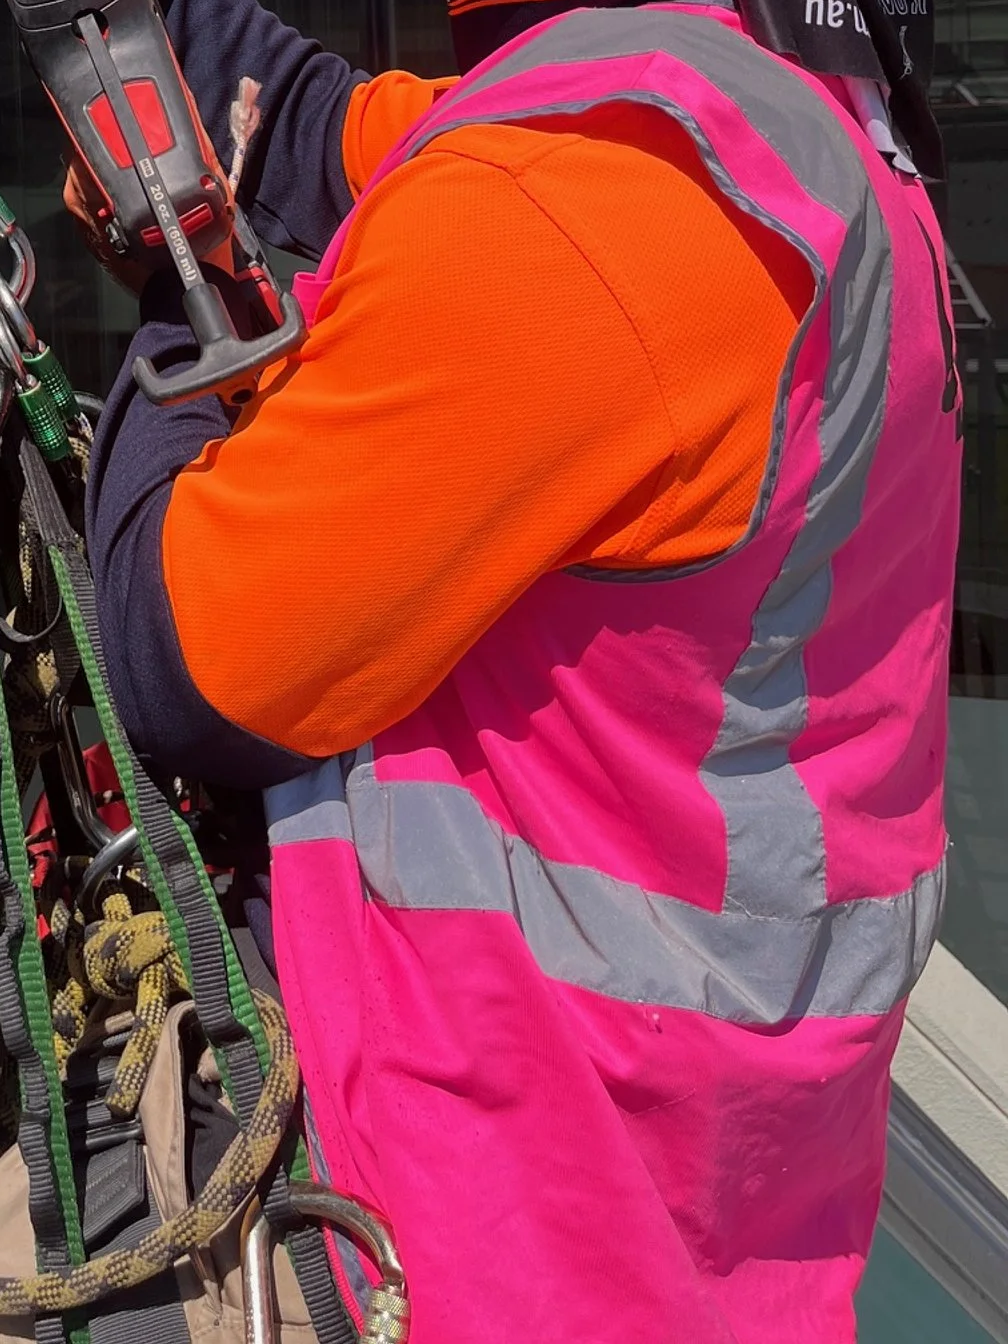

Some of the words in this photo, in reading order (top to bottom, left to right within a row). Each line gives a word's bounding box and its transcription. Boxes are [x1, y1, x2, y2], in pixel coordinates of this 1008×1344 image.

[150, 183, 165, 202] 20
[158, 204, 171, 223] oz.
[180, 258, 198, 282] ml)
